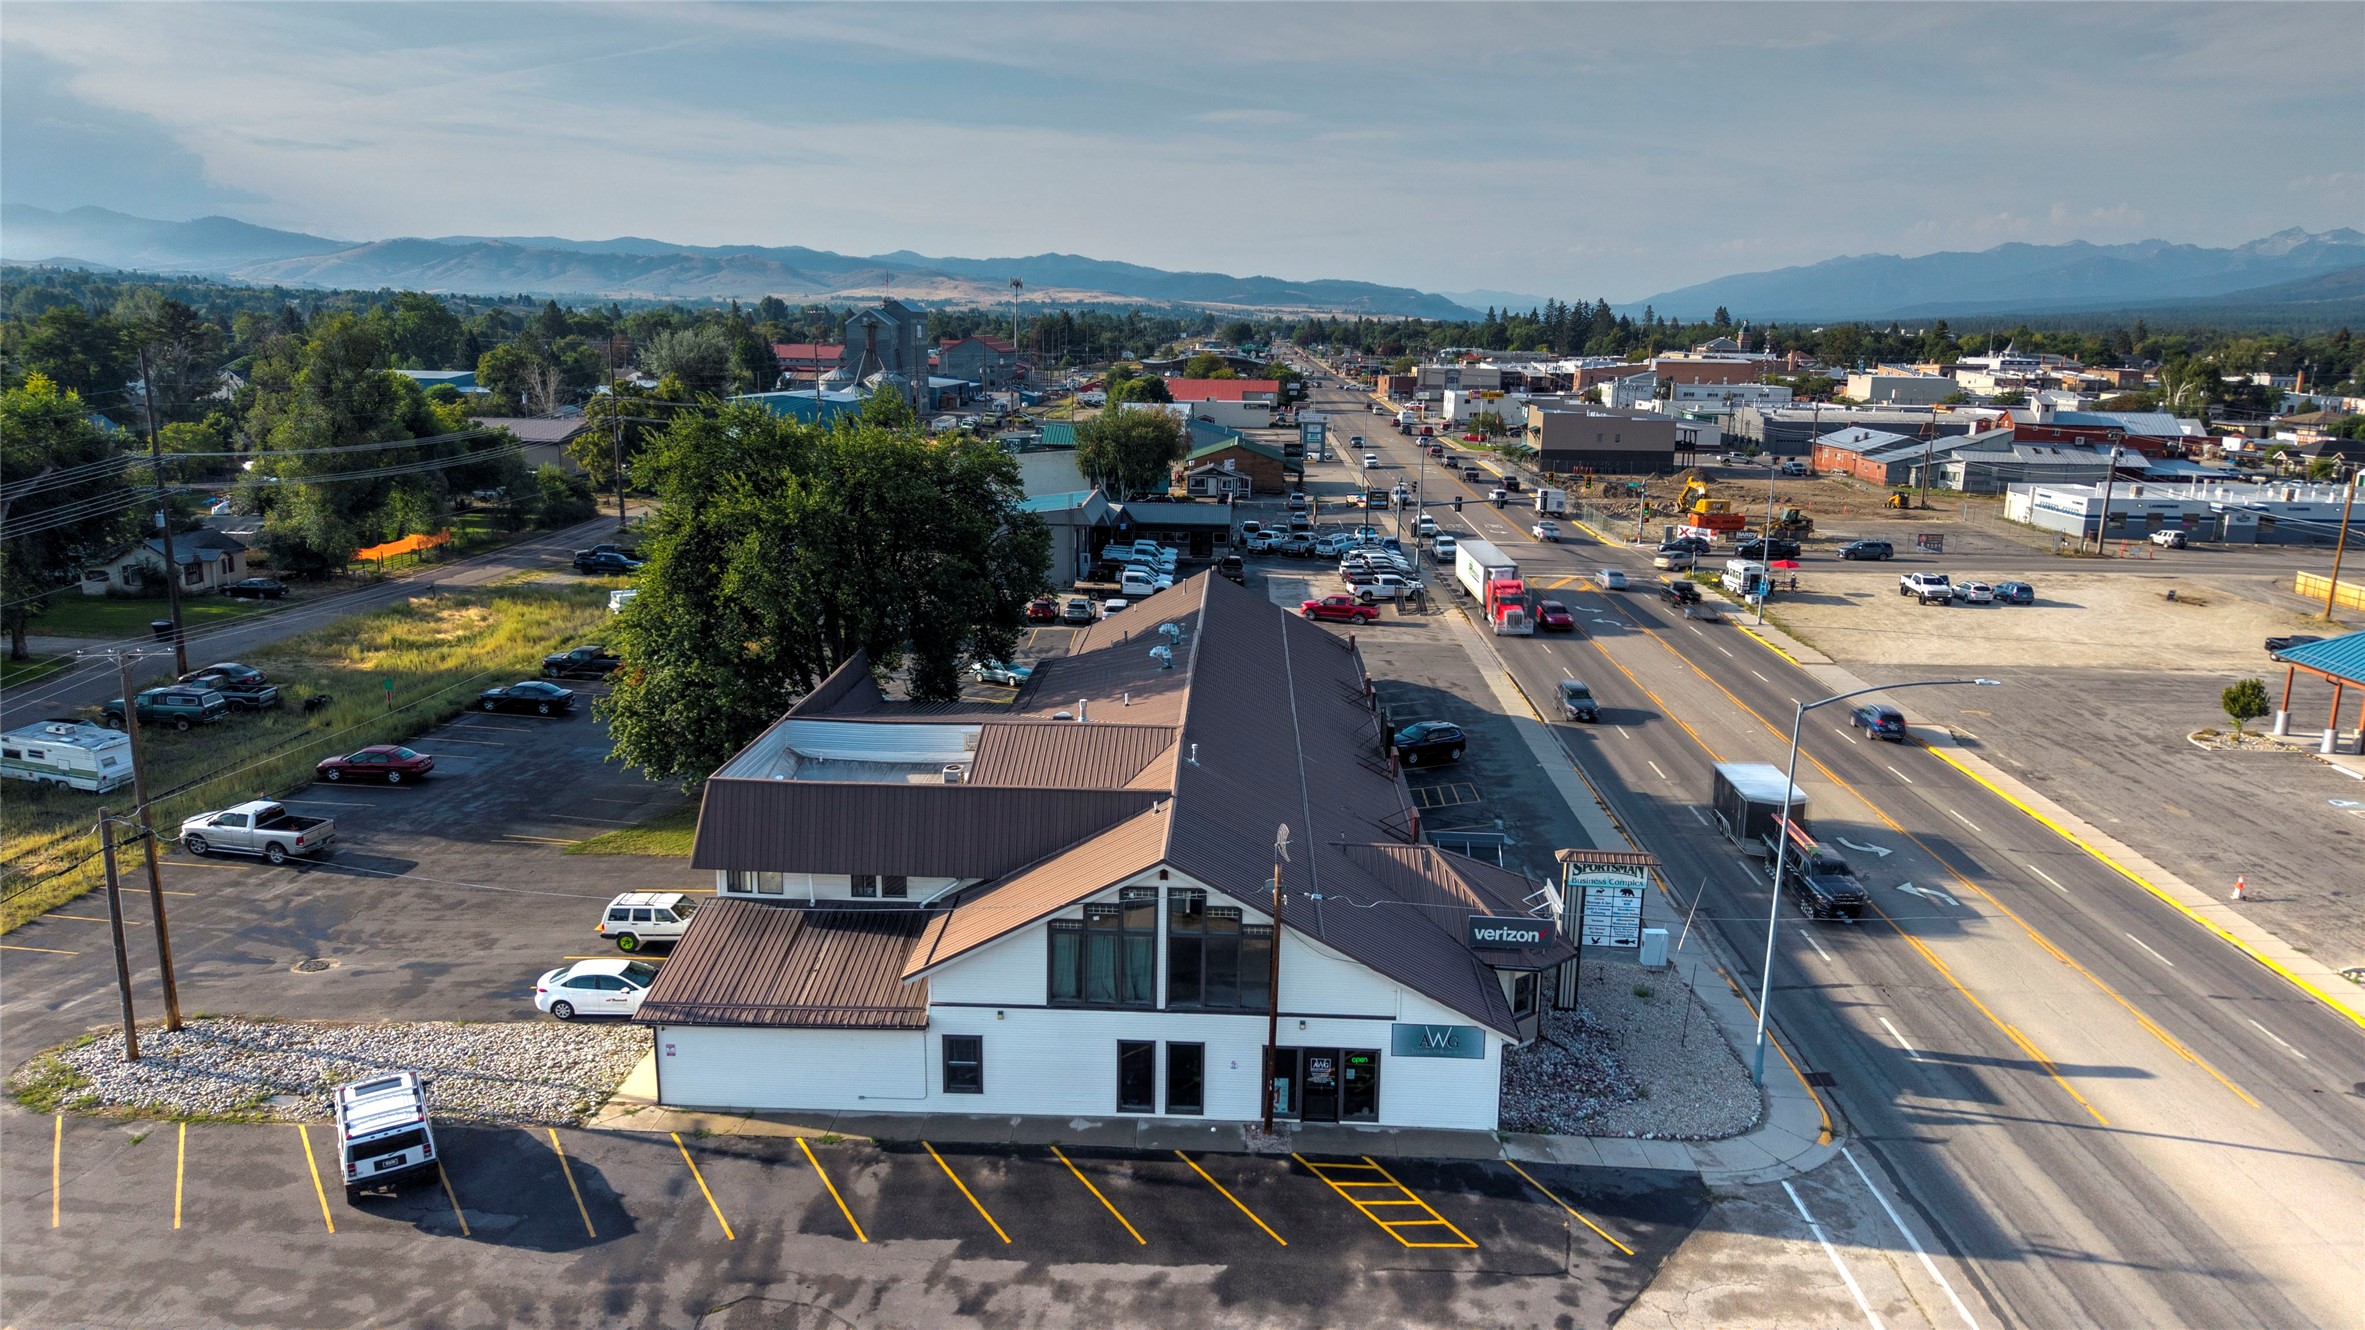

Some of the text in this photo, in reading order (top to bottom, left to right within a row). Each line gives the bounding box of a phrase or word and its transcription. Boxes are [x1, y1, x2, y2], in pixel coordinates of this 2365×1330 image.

[1736, 531, 1758, 539] HARDY
[1572, 863, 1645, 879] SPORTSMAN
[1571, 877, 1644, 887] Business Complex
[1474, 927, 1539, 942] verizon
[1418, 1026, 1459, 1048] AWG
[1351, 1057, 1368, 1065] open
